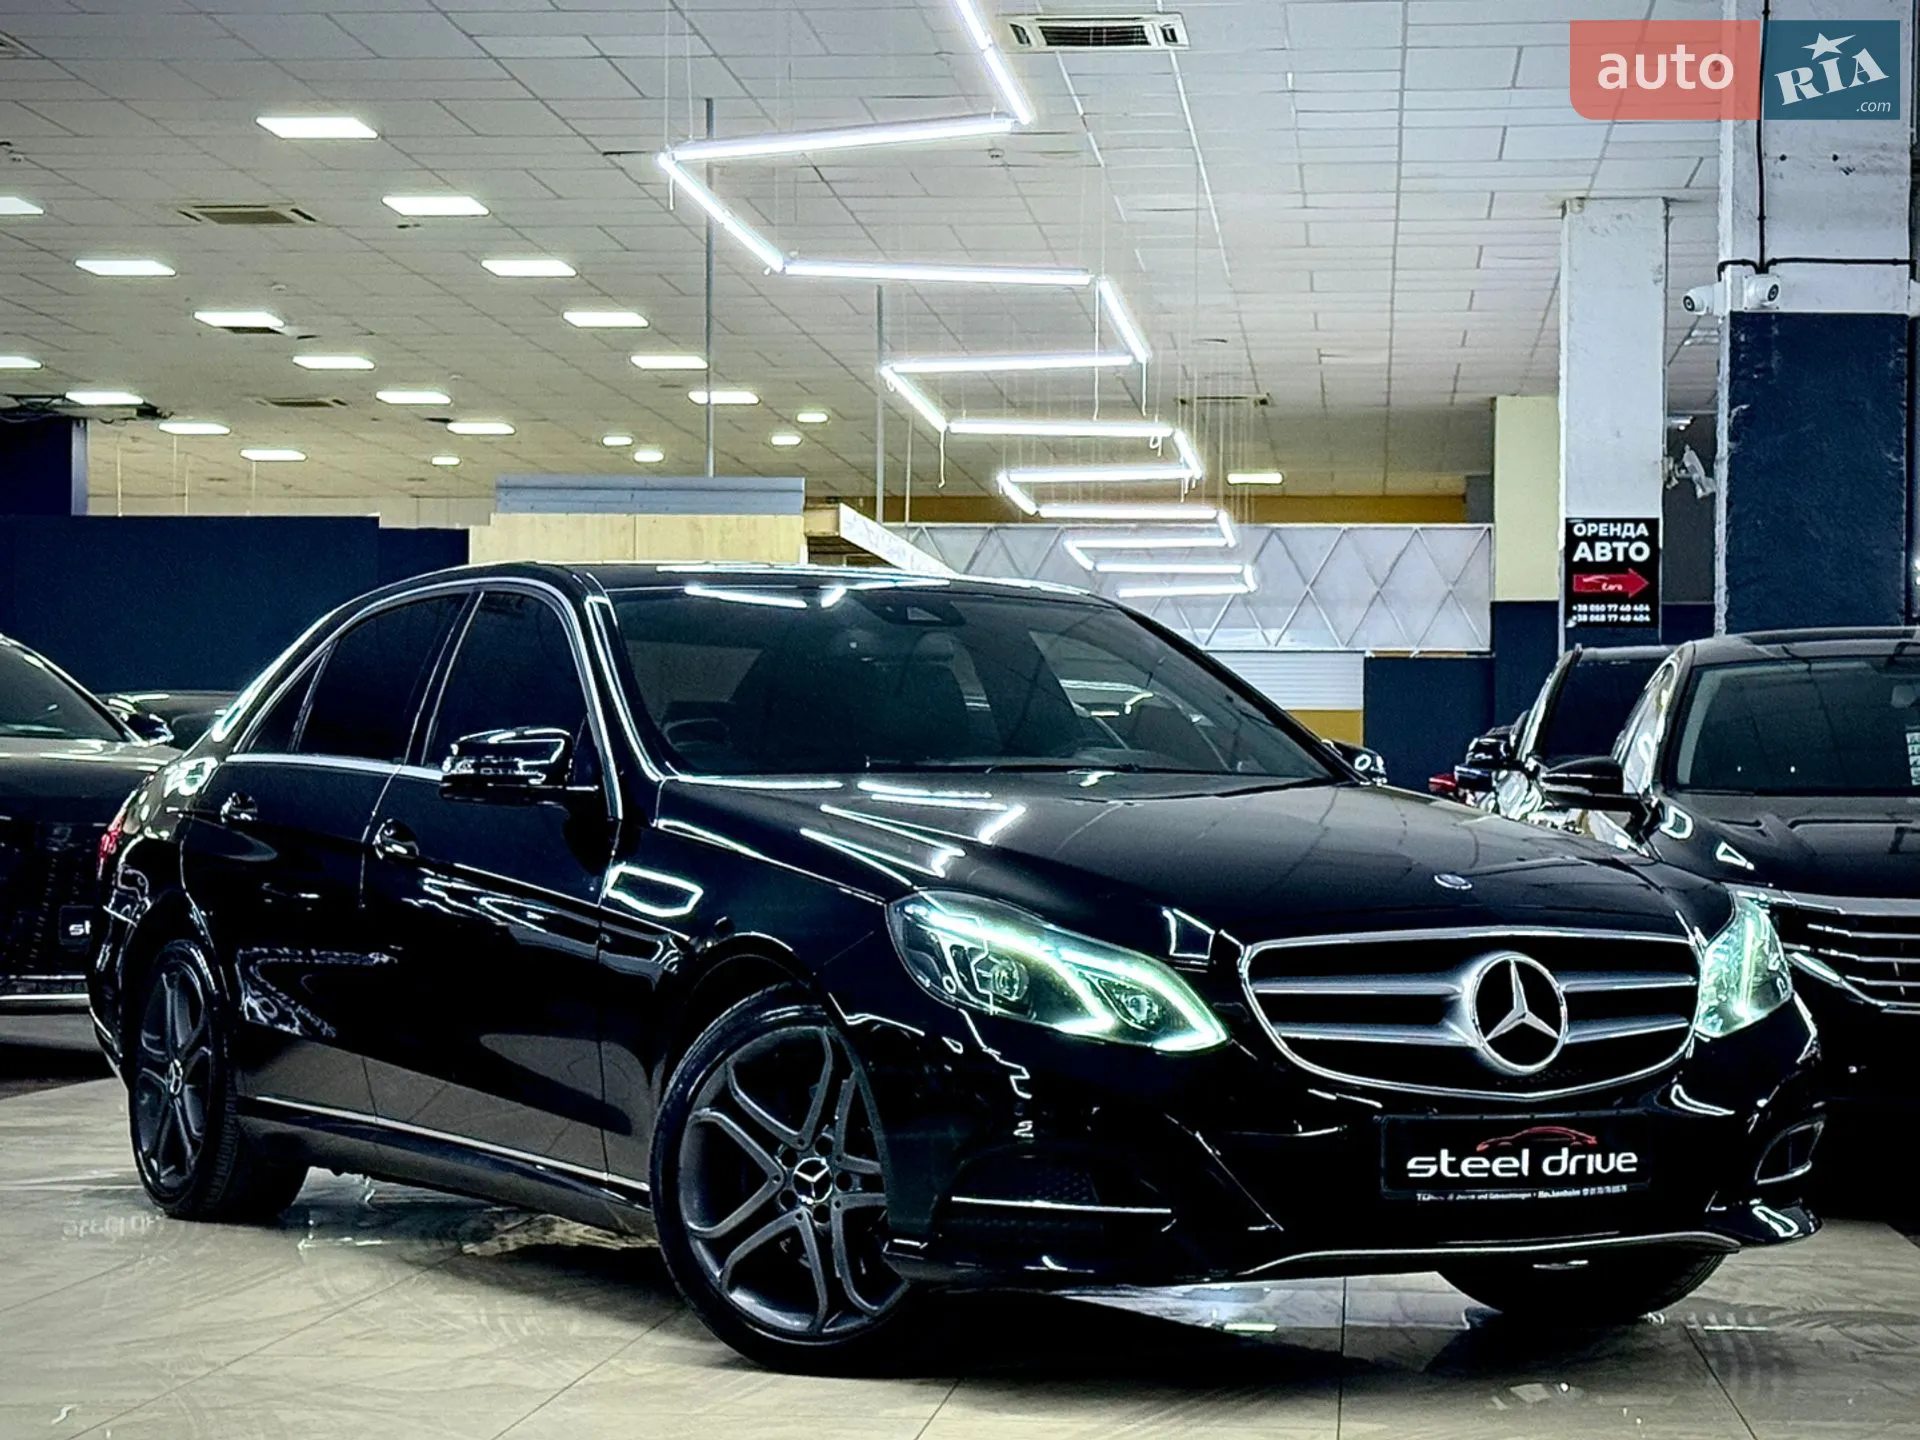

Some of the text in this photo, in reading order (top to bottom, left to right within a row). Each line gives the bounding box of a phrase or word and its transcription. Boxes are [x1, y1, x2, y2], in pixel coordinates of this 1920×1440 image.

[1573, 522, 1649, 539] ОРЕНДА
[1572, 541, 1651, 562] АВТО
[1607, 604, 1618, 612] 77
[1607, 614, 1618, 622] 77
[1406, 1147, 1639, 1178] steel drive
